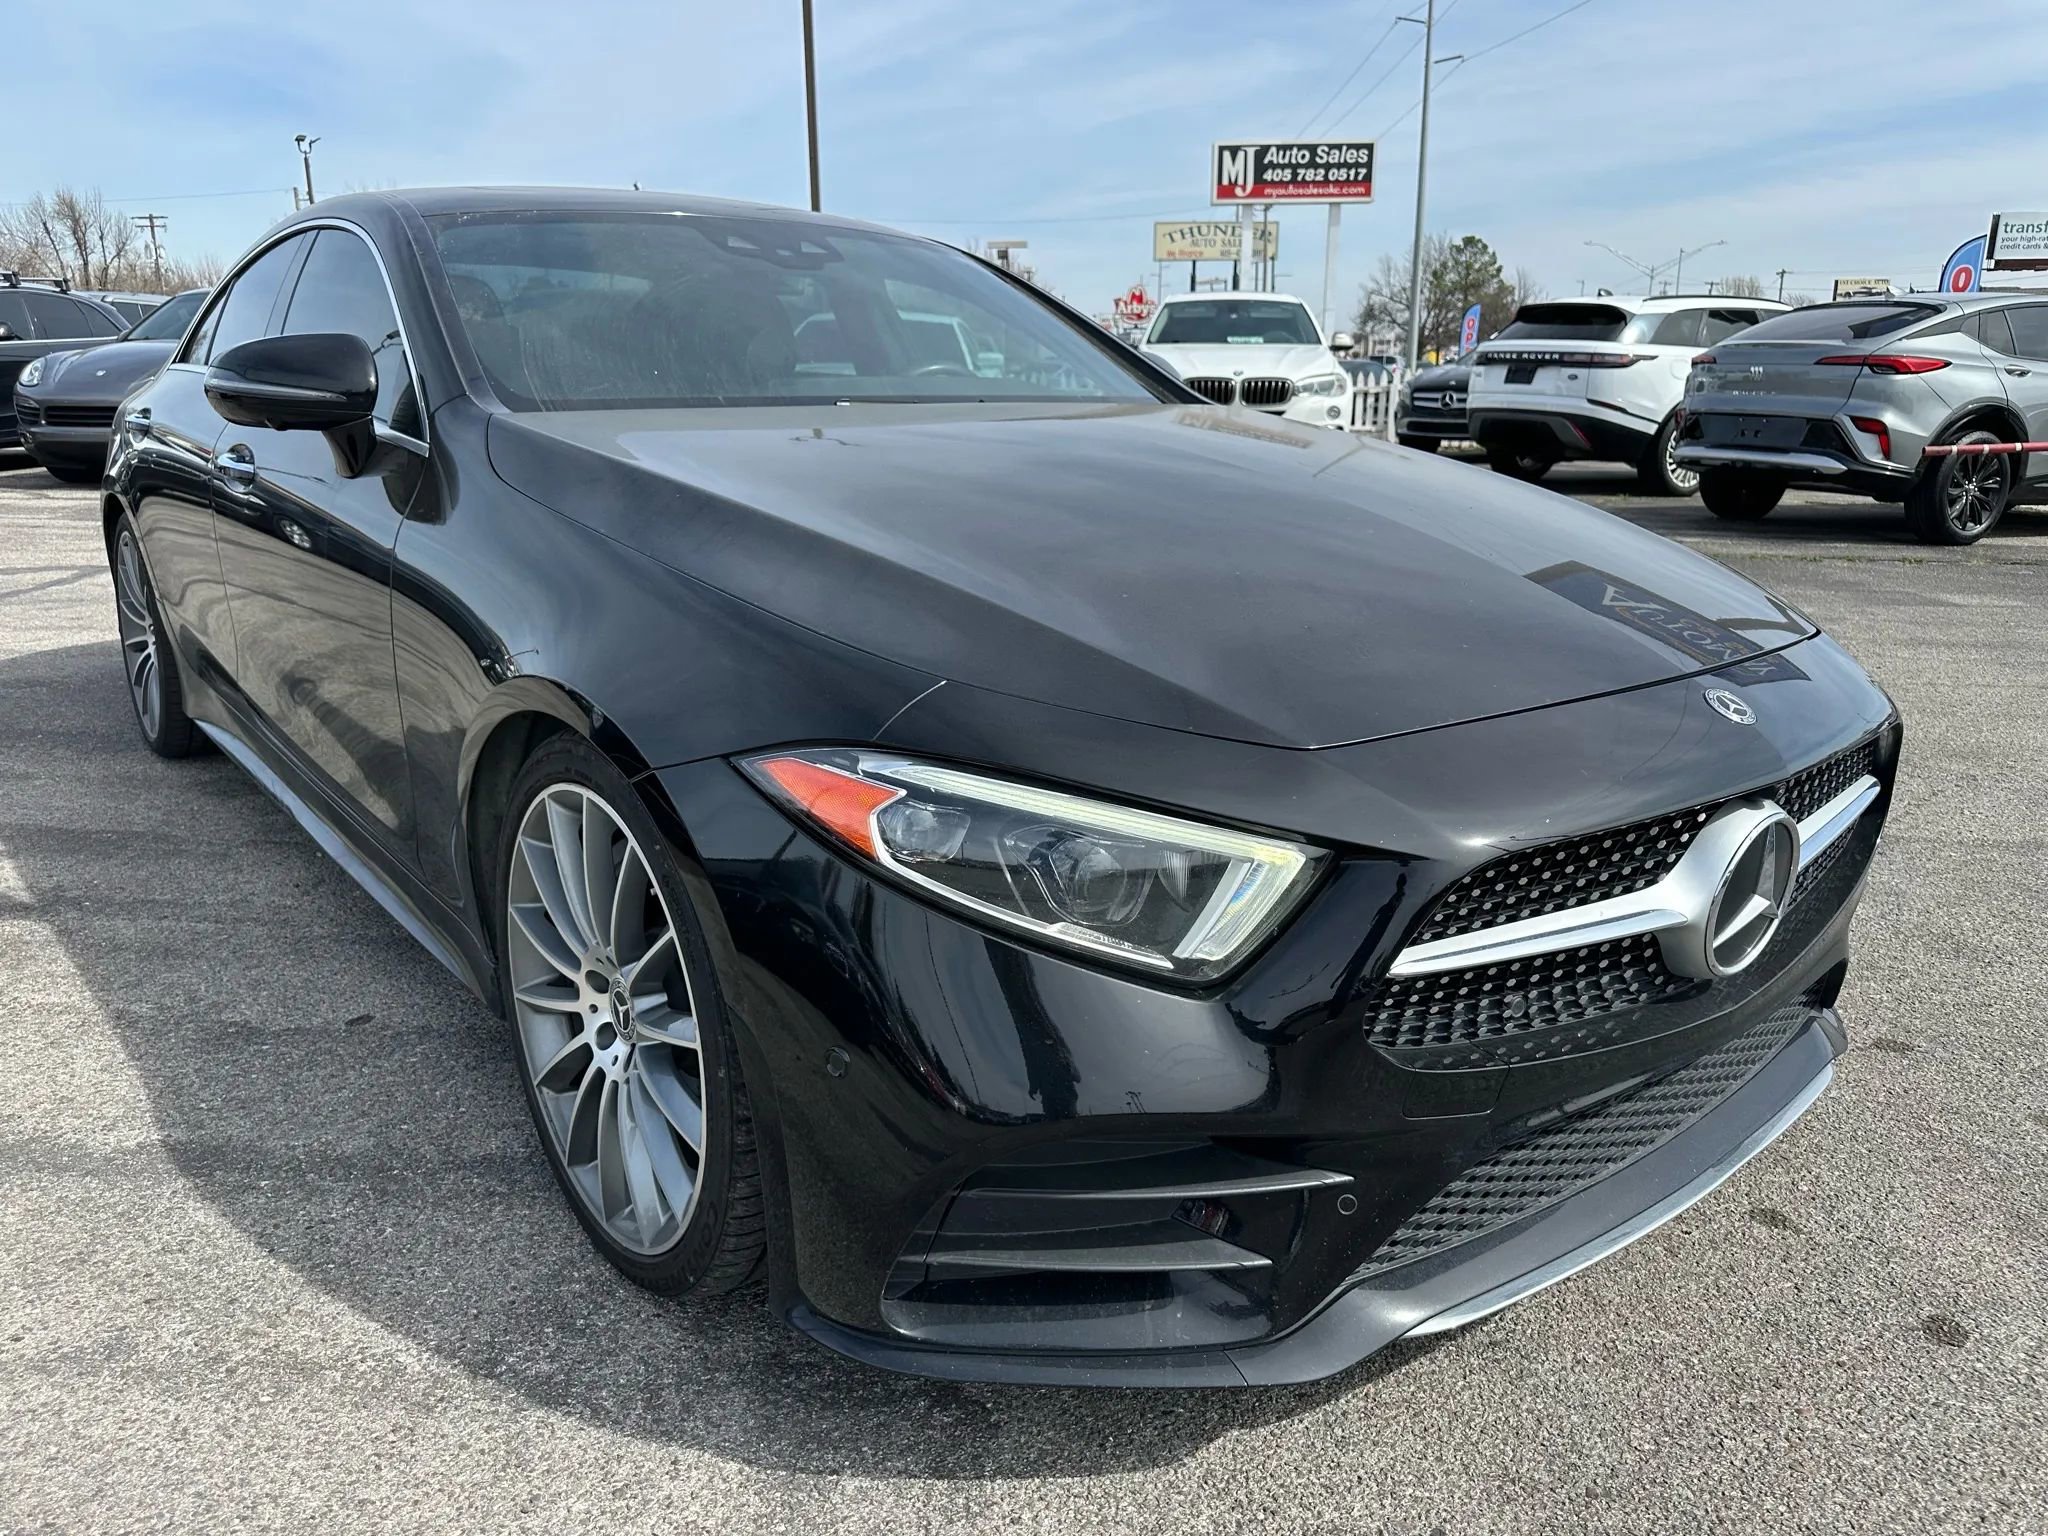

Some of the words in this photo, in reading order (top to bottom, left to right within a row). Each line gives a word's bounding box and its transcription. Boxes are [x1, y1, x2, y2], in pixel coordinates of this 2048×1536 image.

[1264, 146, 1310, 164] Auto
[1315, 145, 1369, 163] Sales
[1222, 147, 1261, 197] MJ
[1263, 169, 1292, 181] 405
[1297, 168, 1325, 181] 782
[1328, 168, 1367, 181] 0517
[1190, 238, 1217, 248] AUTO
